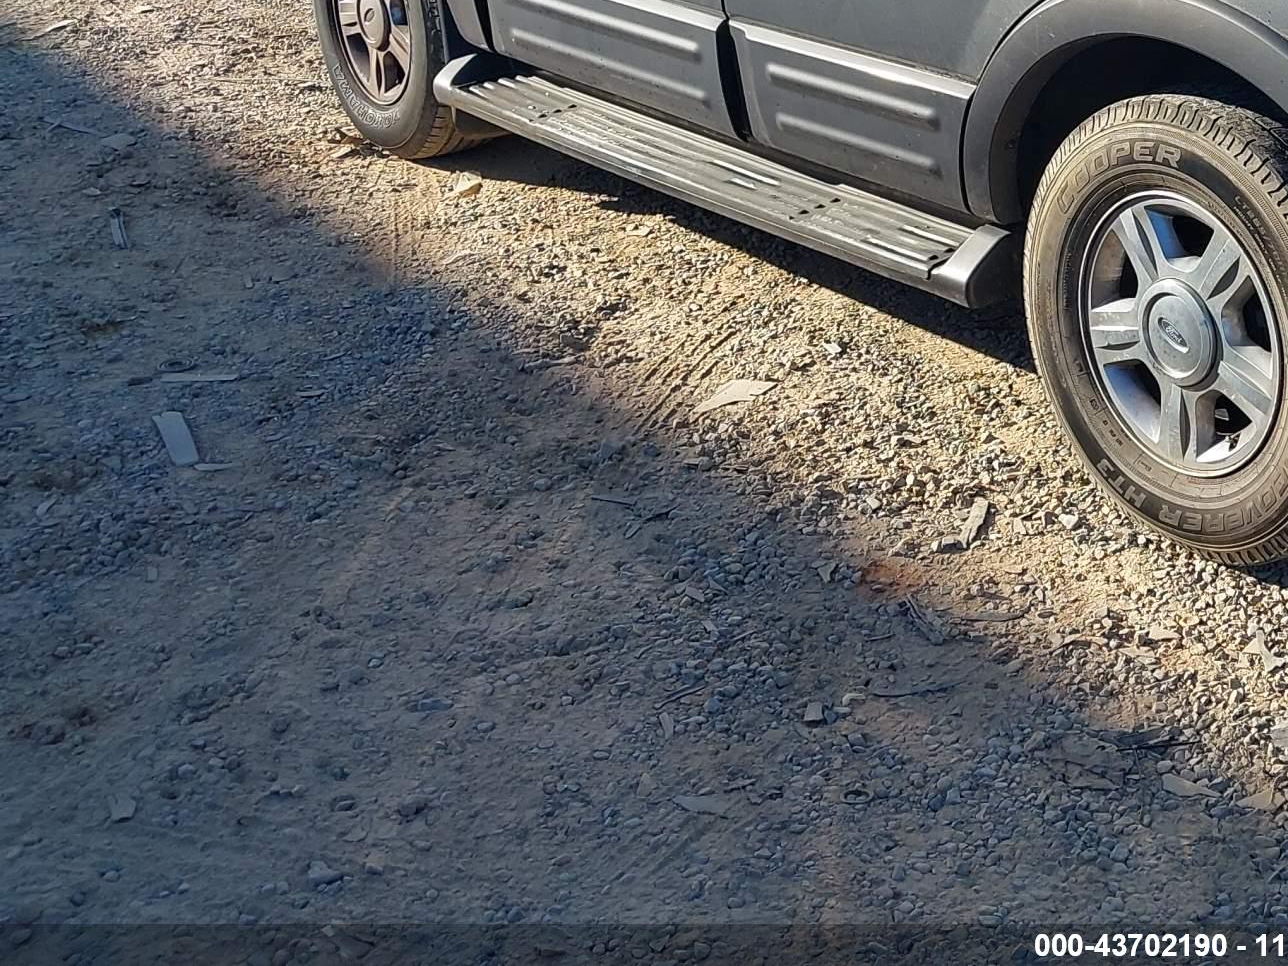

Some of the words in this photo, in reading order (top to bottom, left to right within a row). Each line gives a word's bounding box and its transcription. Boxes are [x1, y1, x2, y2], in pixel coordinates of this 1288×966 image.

[332, 62, 401, 131] YOKOHAMA
[1056, 141, 1183, 214] COOPER
[1096, 458, 1148, 508] HT3
